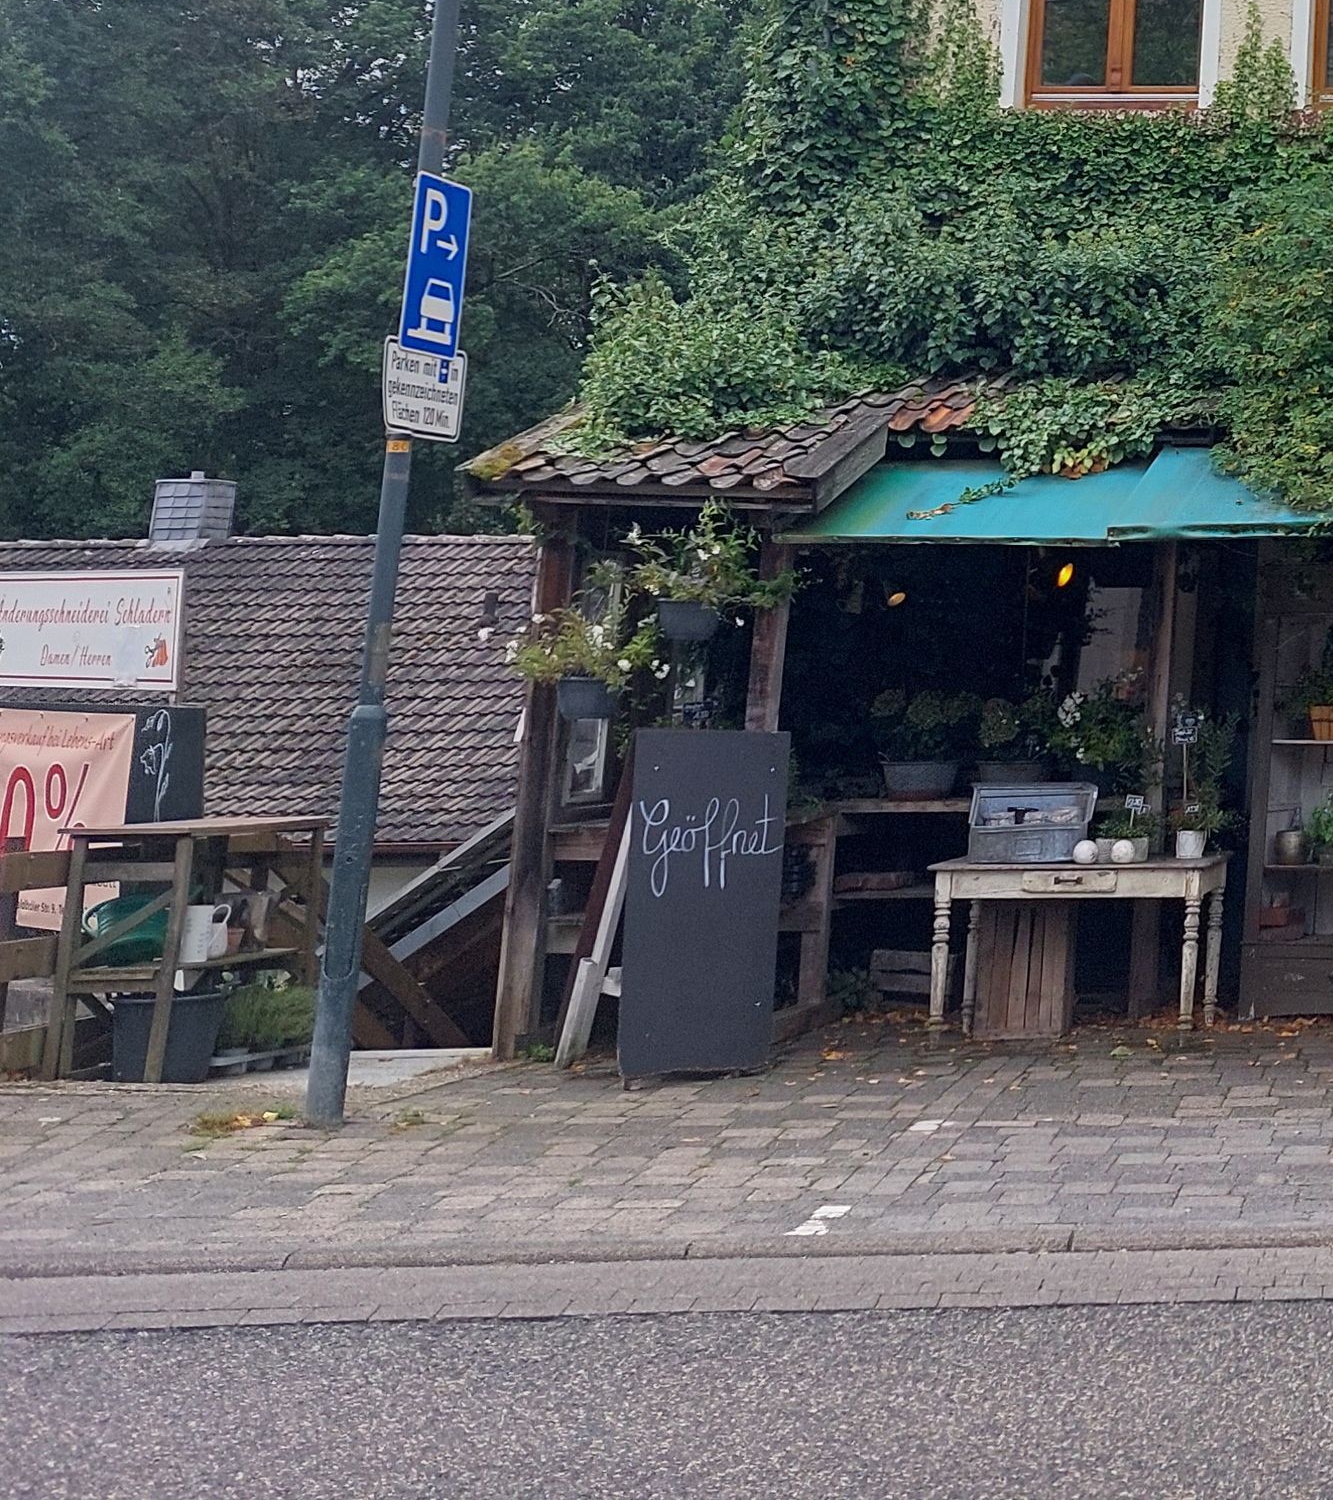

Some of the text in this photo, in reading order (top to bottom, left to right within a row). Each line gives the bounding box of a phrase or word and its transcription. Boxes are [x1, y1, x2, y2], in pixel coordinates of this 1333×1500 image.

[420, 187, 449, 254] P
[391, 350, 459, 382] Parken mit in
[388, 377, 459, 406] gekennzeichneten
[391, 400, 451, 429] Flächen 120 Min.
[639, 793, 785, 898] Geöffnet
